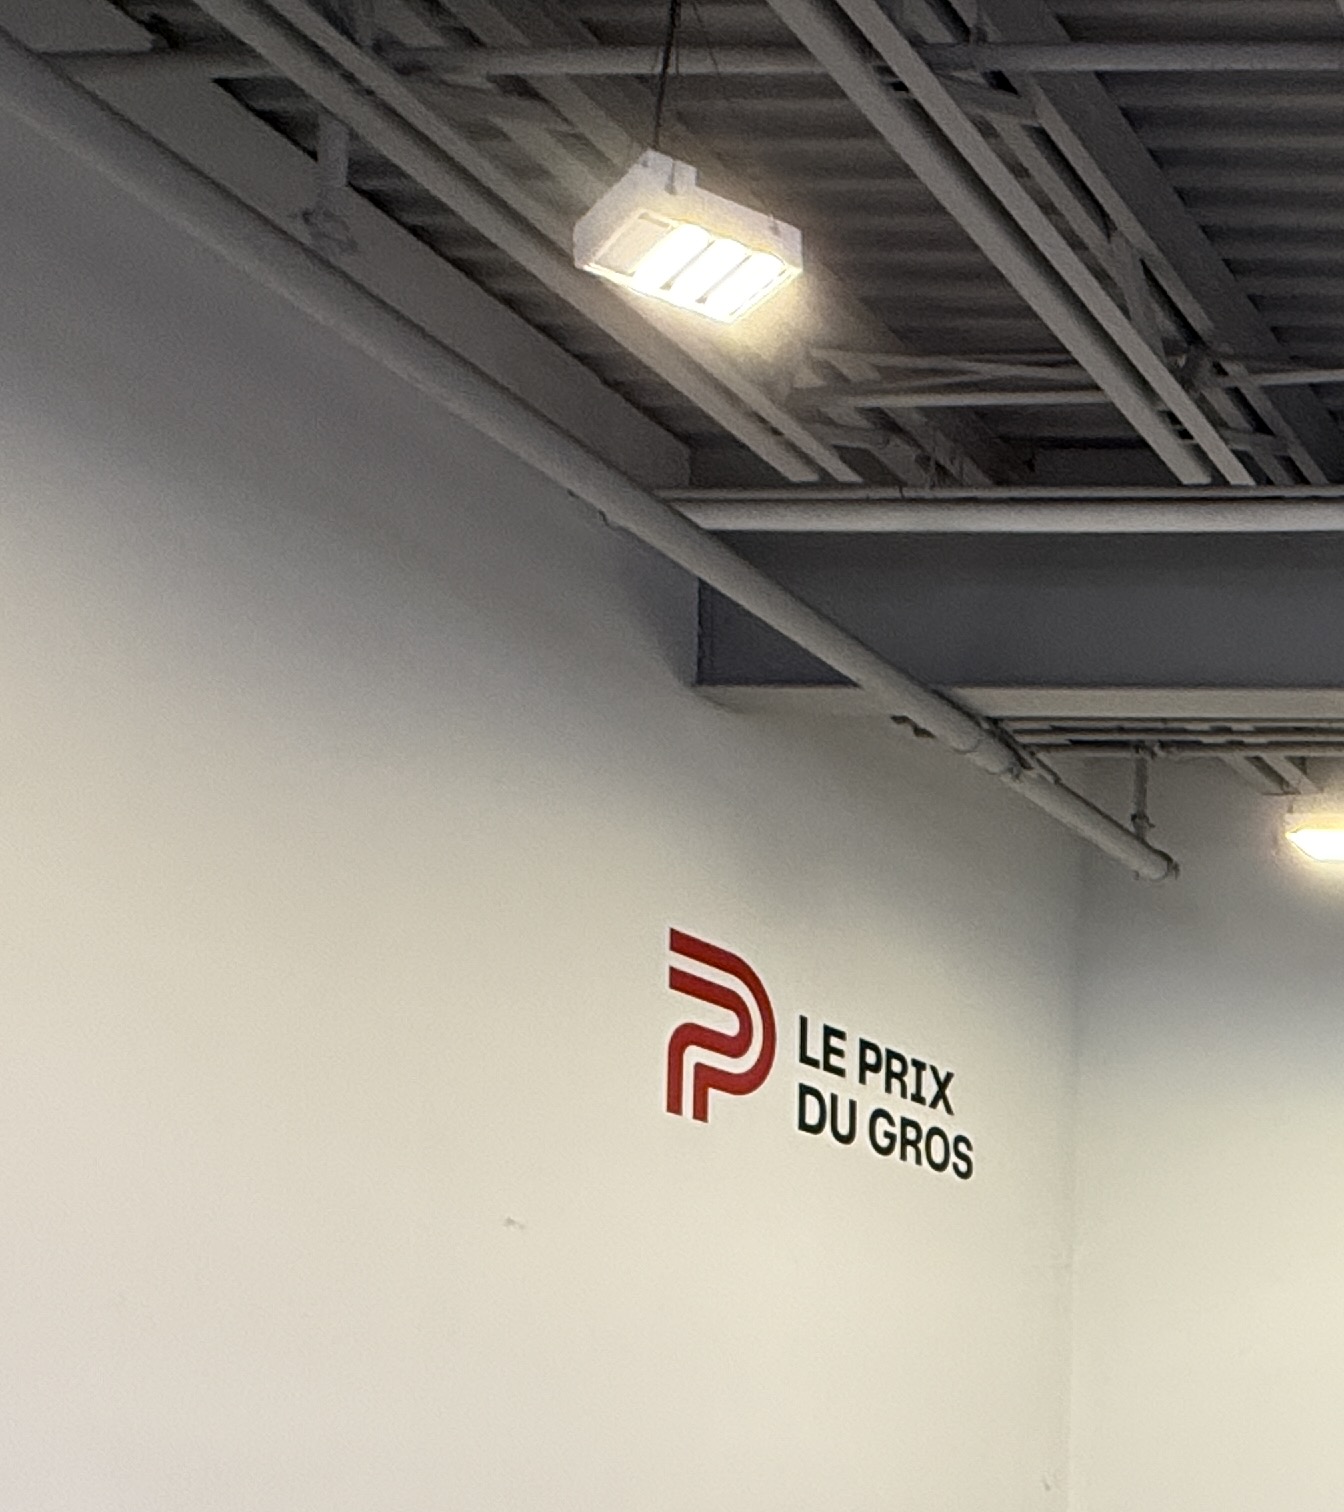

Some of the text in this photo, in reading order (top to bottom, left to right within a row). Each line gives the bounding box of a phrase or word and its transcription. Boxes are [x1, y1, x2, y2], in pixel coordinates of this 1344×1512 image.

[798, 1014, 955, 1116] LE PRIX
[797, 1082, 974, 1181] DU GROS
